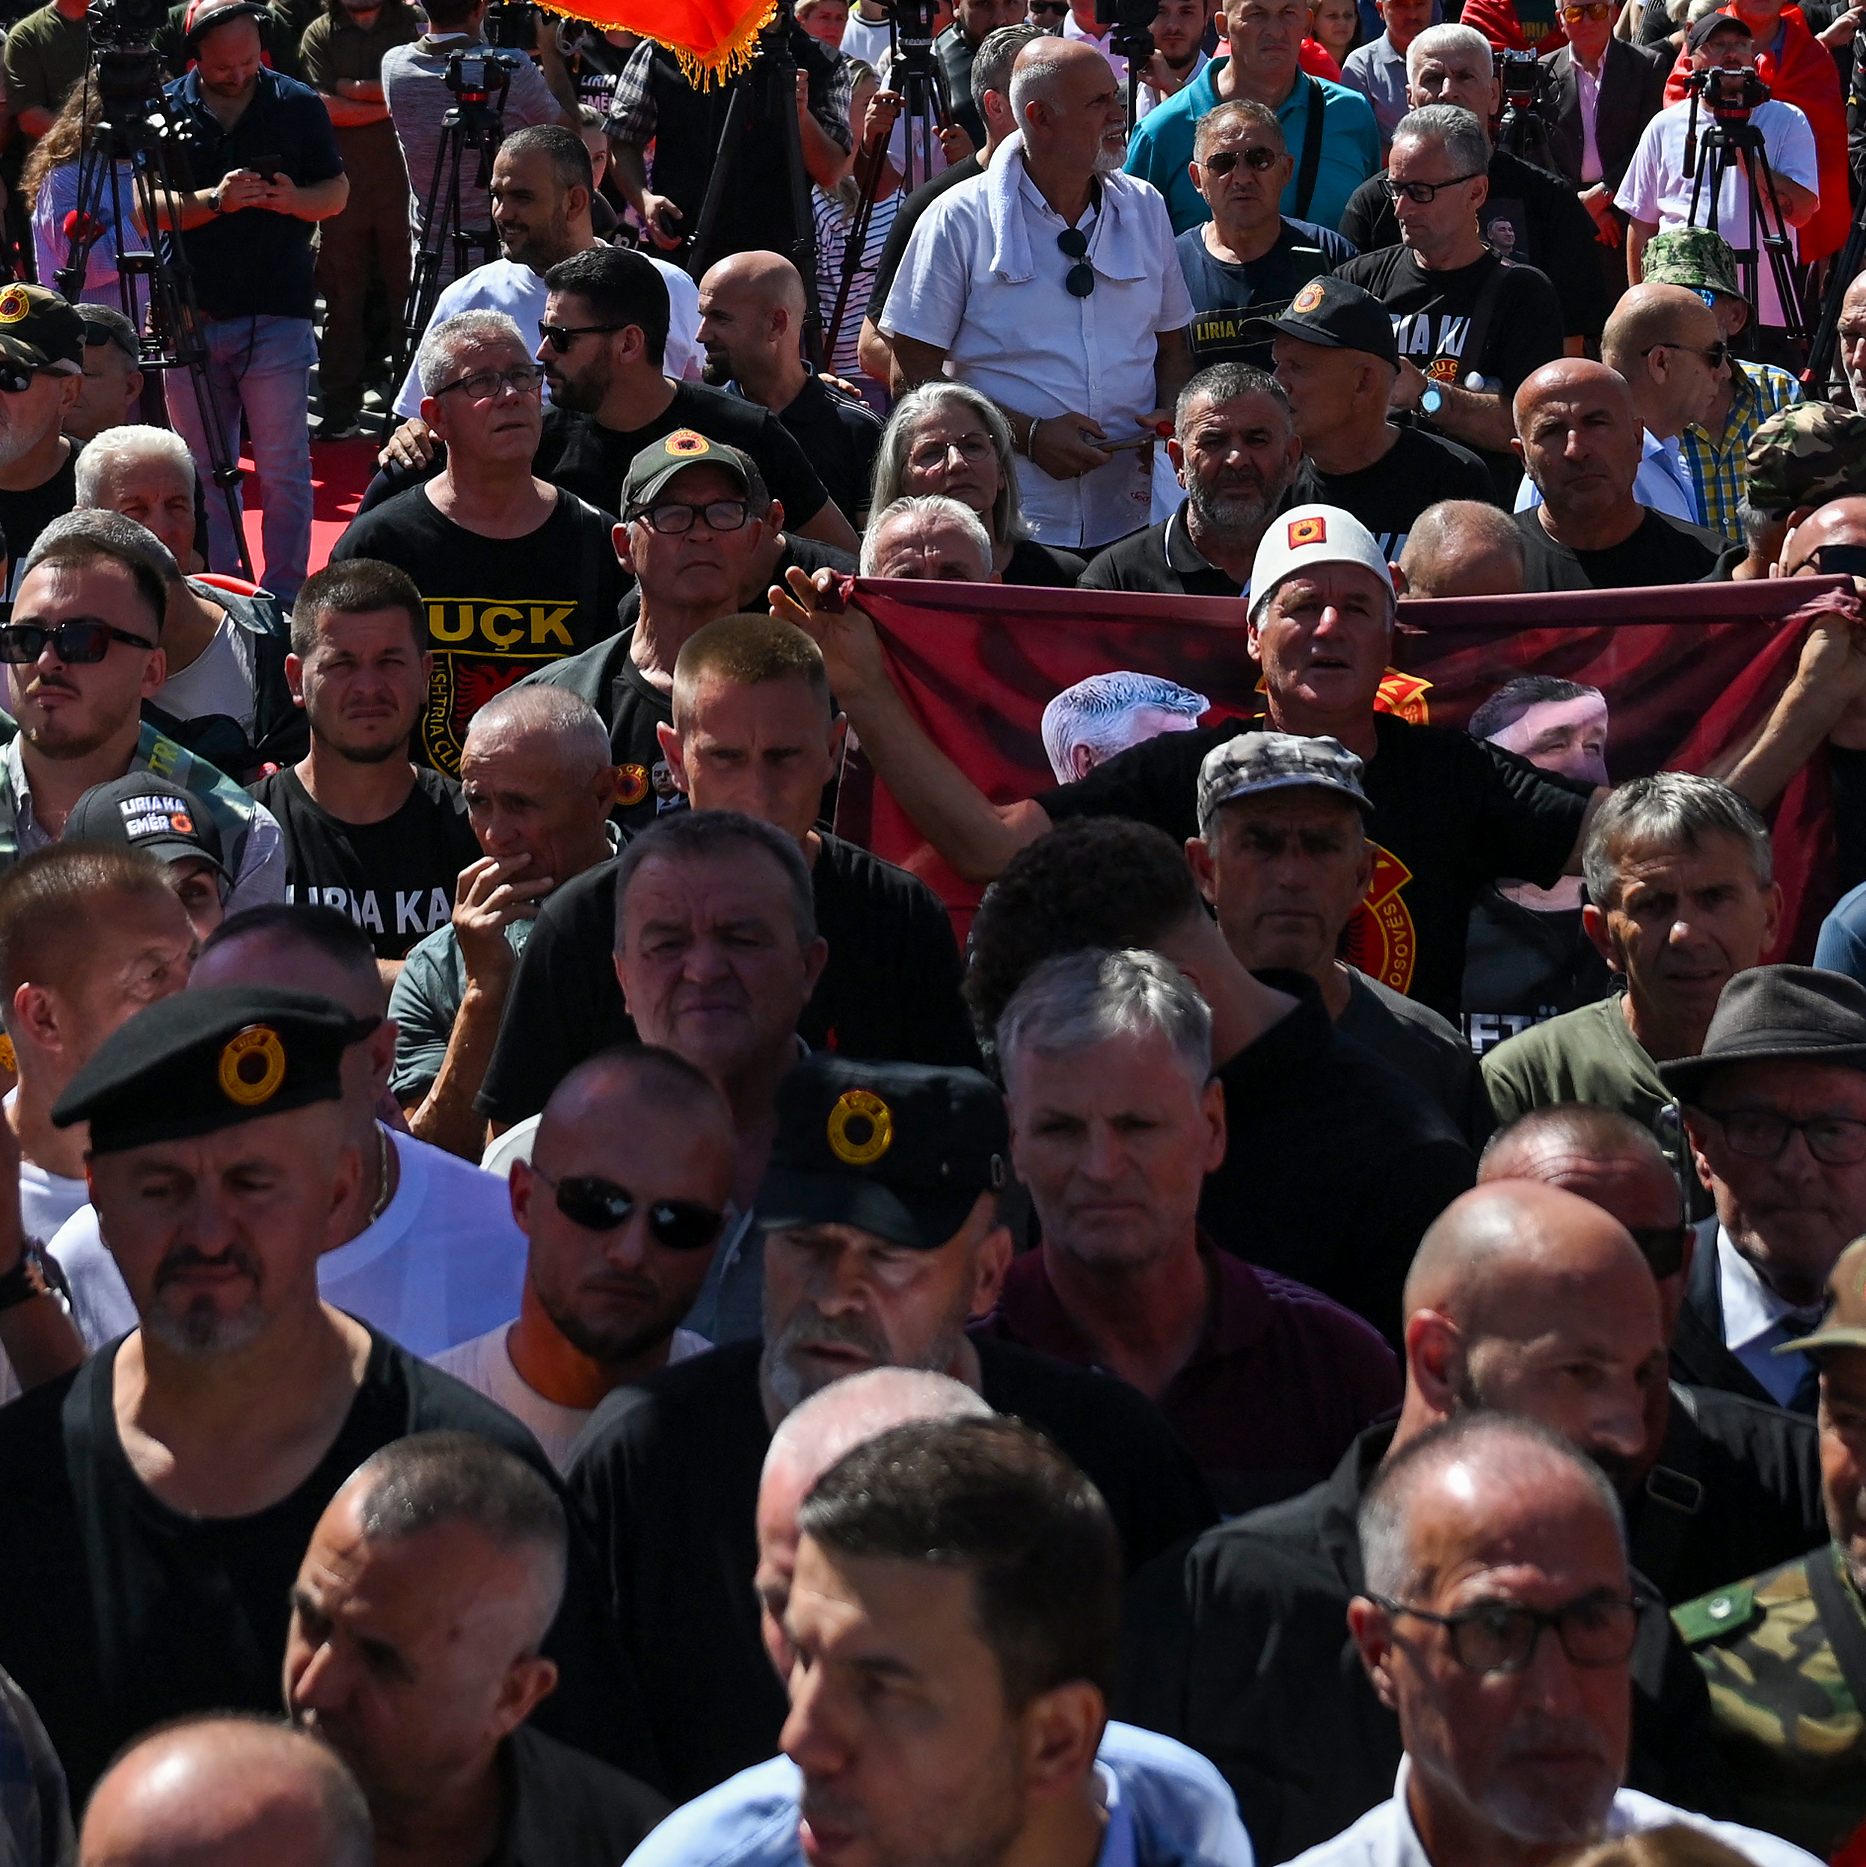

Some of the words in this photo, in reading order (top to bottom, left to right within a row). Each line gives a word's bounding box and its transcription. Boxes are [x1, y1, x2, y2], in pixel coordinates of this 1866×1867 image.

[1196, 320, 1236, 342] LIRIA
[428, 603, 575, 652] UÇK
[1382, 902, 1409, 987] OSOVËS
